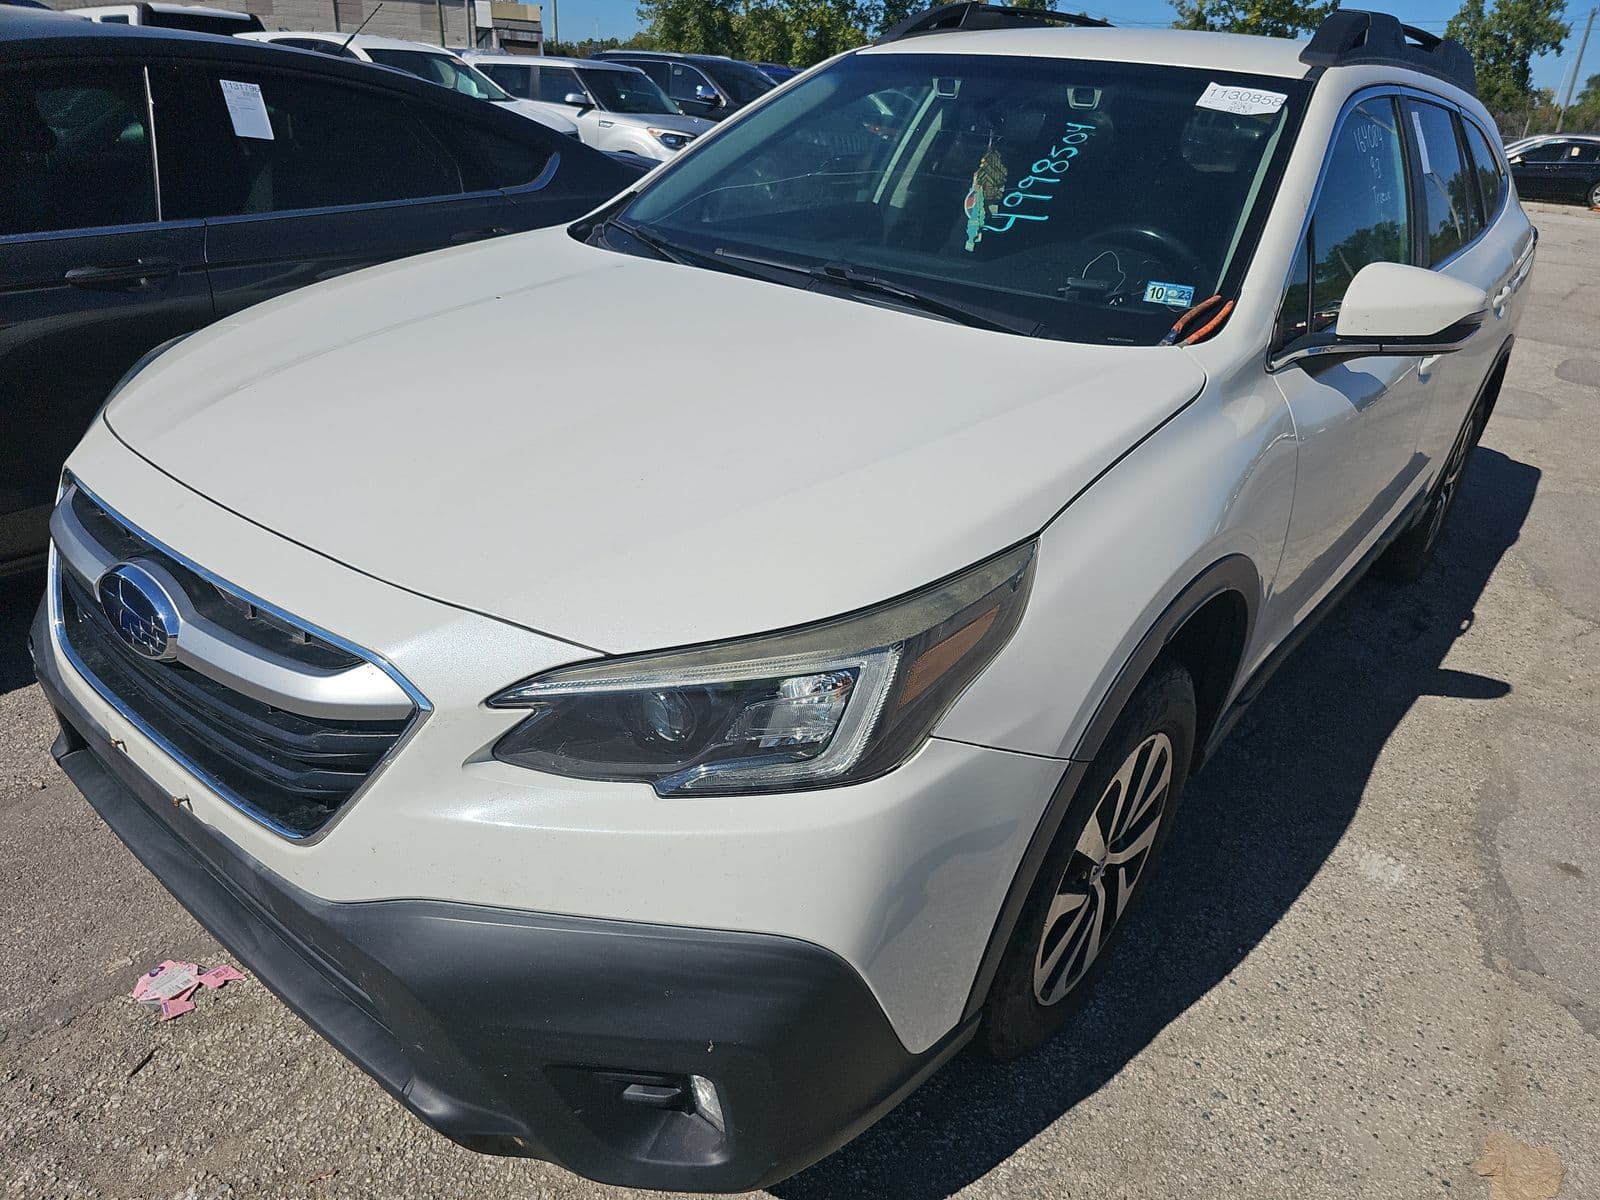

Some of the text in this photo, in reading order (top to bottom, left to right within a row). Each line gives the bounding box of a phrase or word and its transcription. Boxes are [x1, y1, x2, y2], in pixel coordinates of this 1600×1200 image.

[1210, 88, 1284, 107] 1130858
[982, 122, 1096, 232] 4998504
[1150, 286, 1192, 301] 10 23
